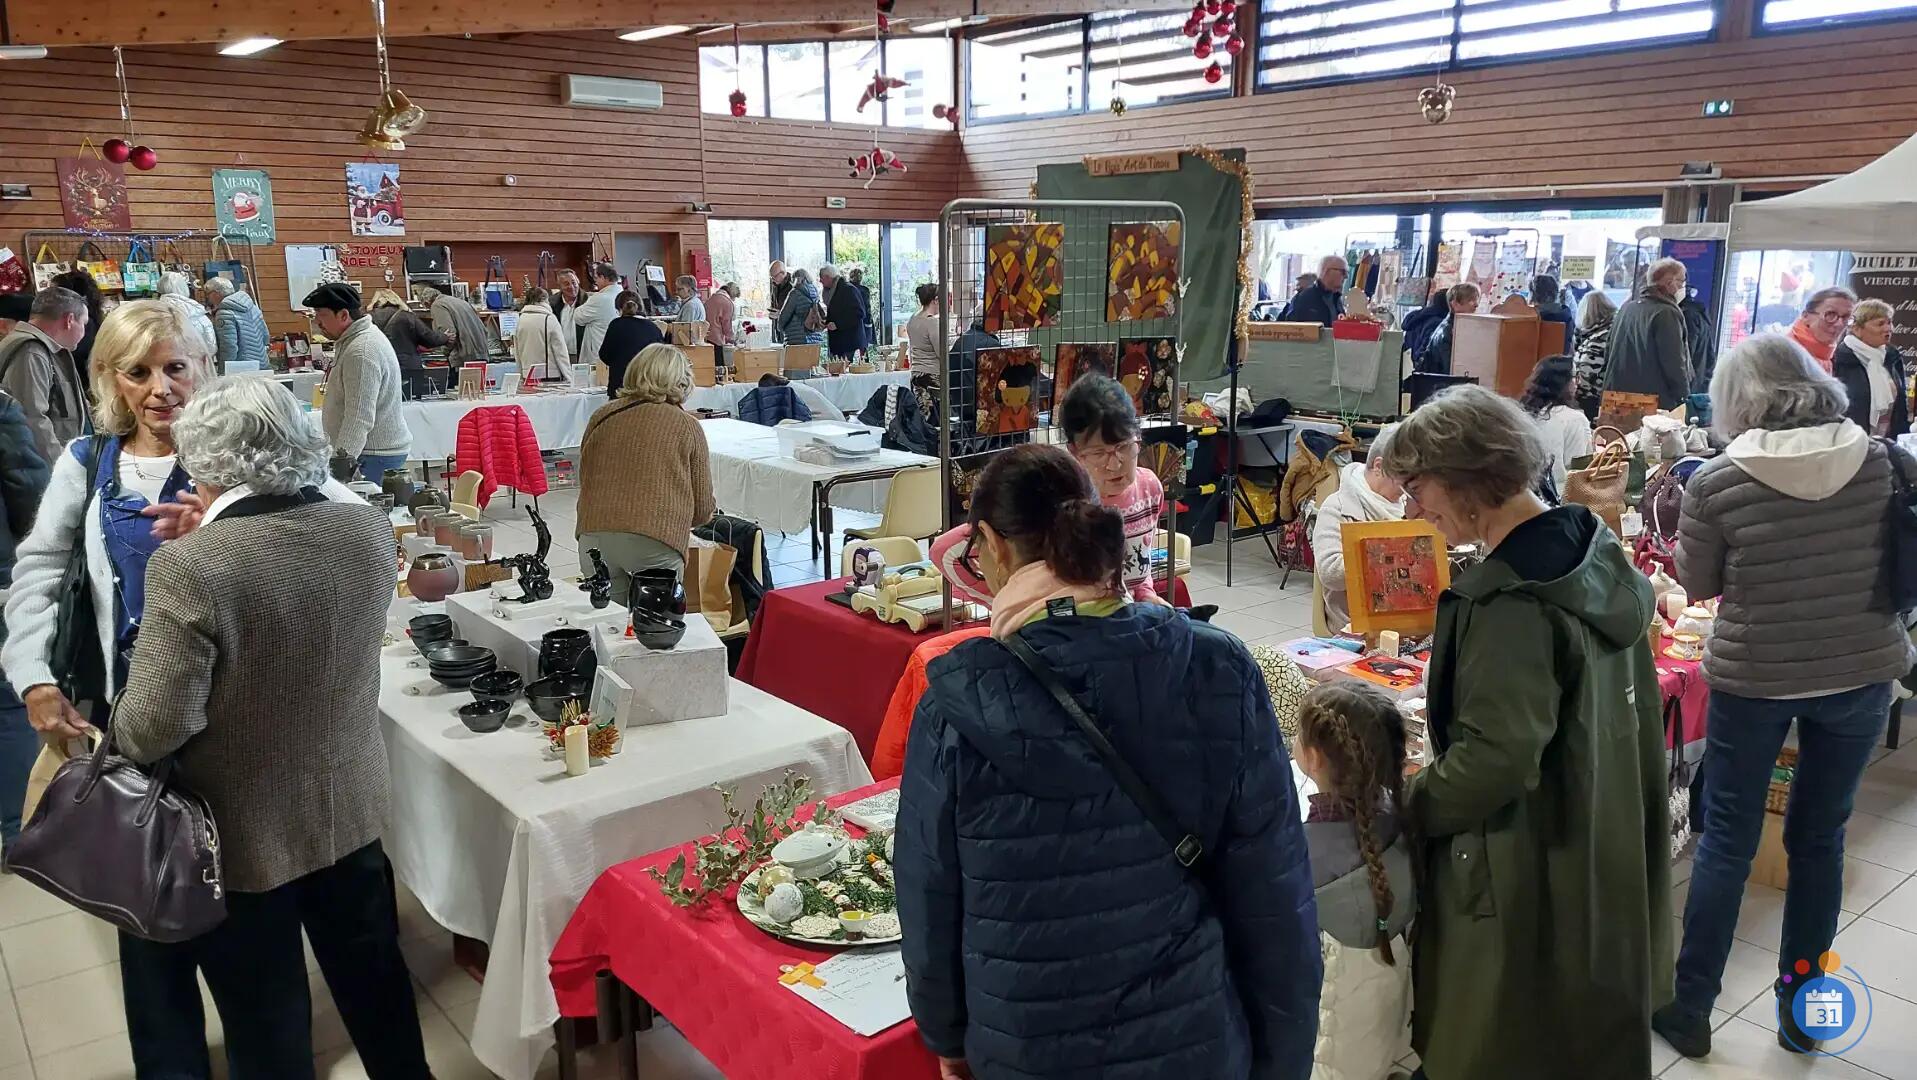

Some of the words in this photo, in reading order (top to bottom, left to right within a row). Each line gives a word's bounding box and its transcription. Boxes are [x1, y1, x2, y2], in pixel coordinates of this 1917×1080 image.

[223, 177, 262, 193] MERRY
[353, 245, 404, 255] JOYEUX
[1856, 256, 1904, 268] HUILE
[1863, 276, 1910, 286] VIERGE
